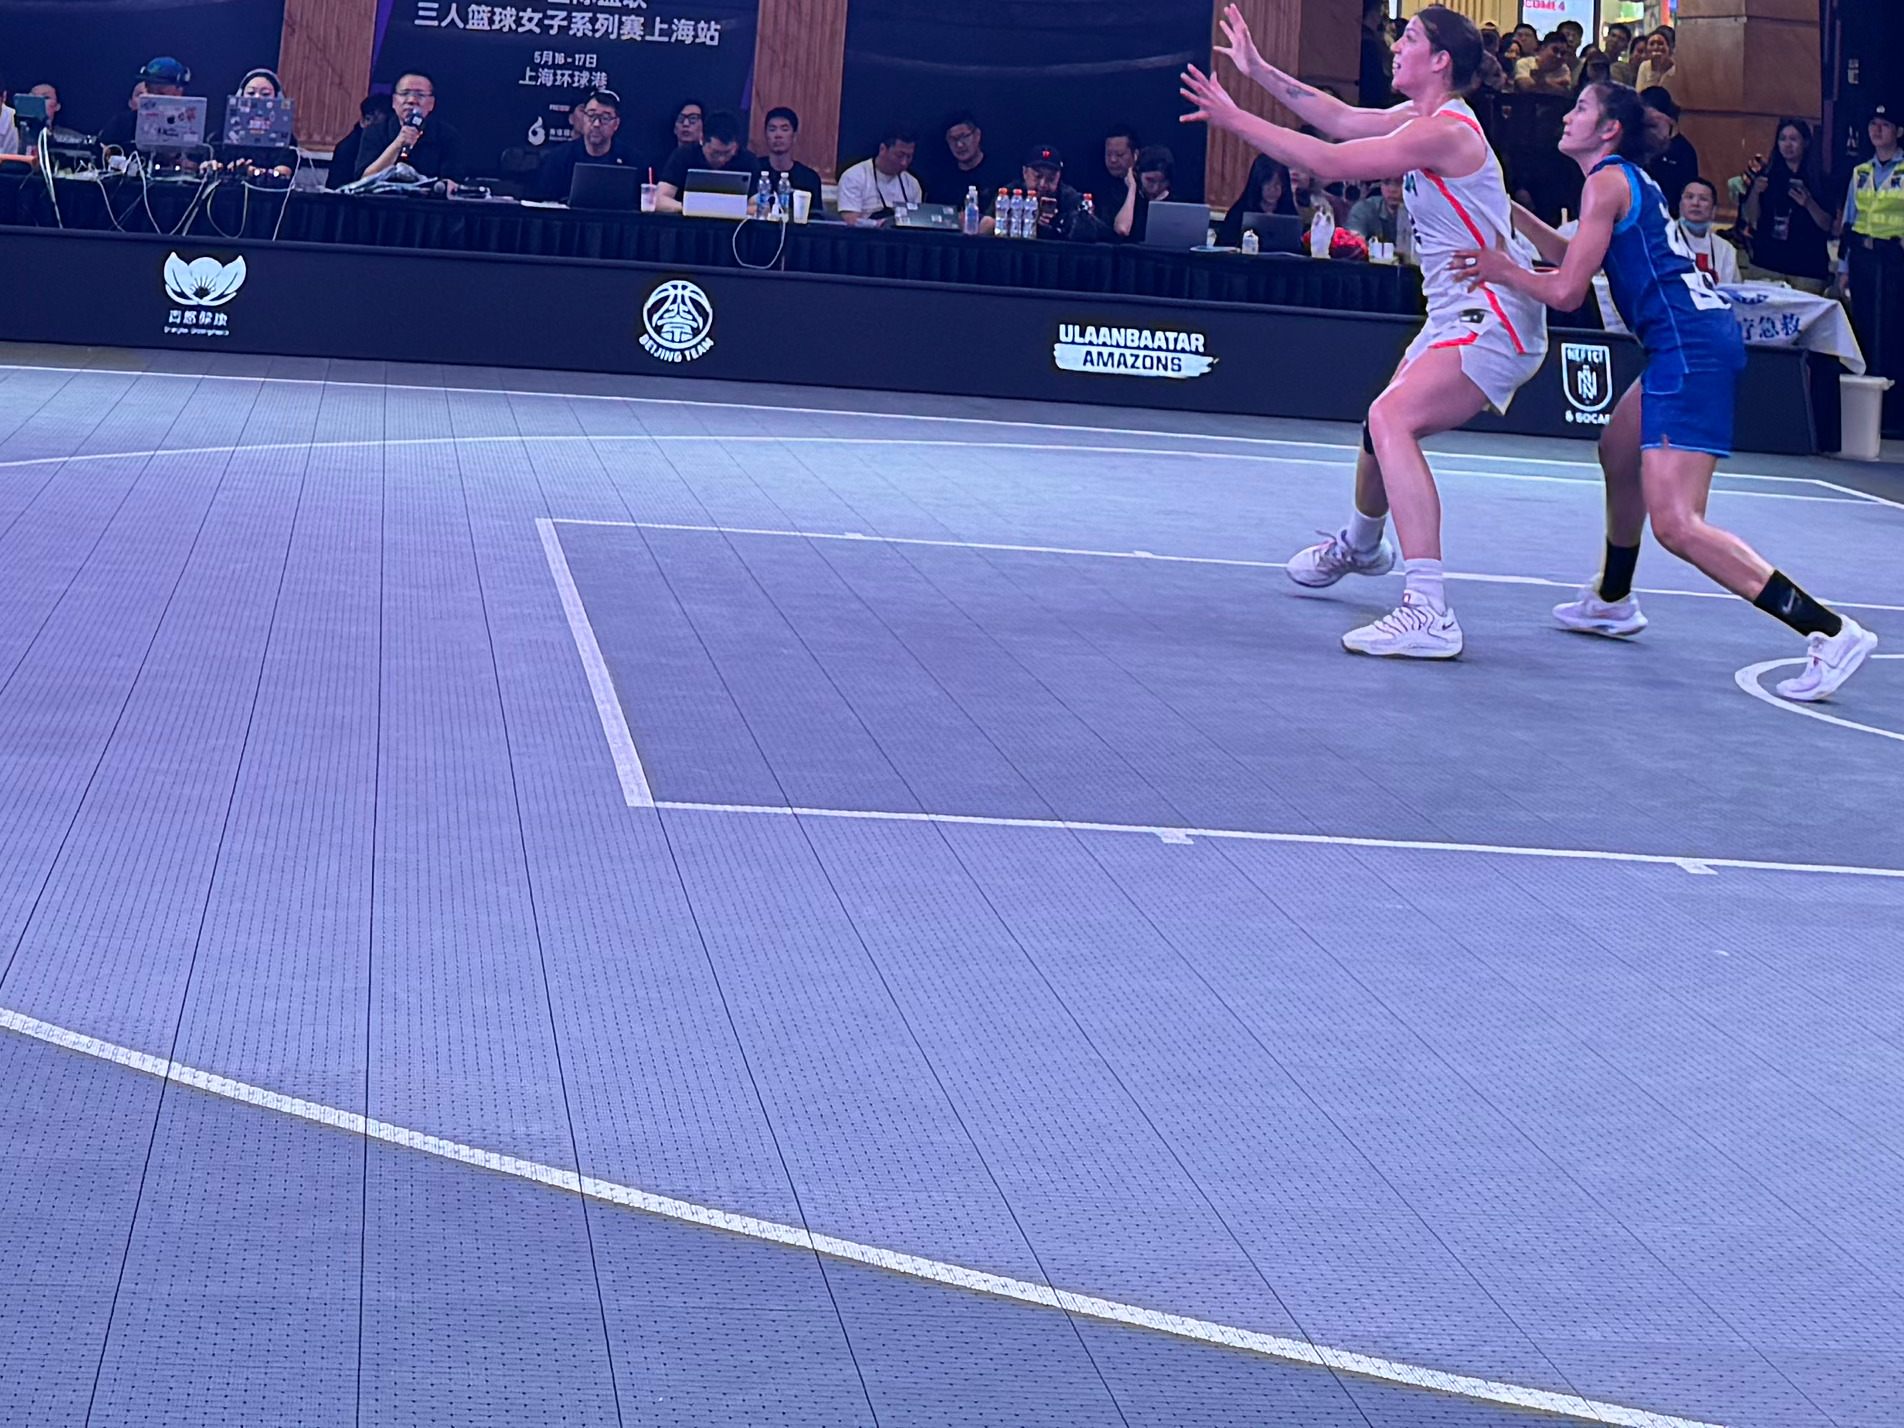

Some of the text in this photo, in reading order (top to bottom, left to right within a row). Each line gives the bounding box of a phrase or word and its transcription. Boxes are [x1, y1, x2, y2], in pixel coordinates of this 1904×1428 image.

[414, 1, 721, 46] 三人篮球女子系列赛上海站
[519, 66, 607, 90] 上海环球港
[1059, 324, 1205, 352] ULAANBAATAR
[1083, 350, 1182, 372] AMAZONS
